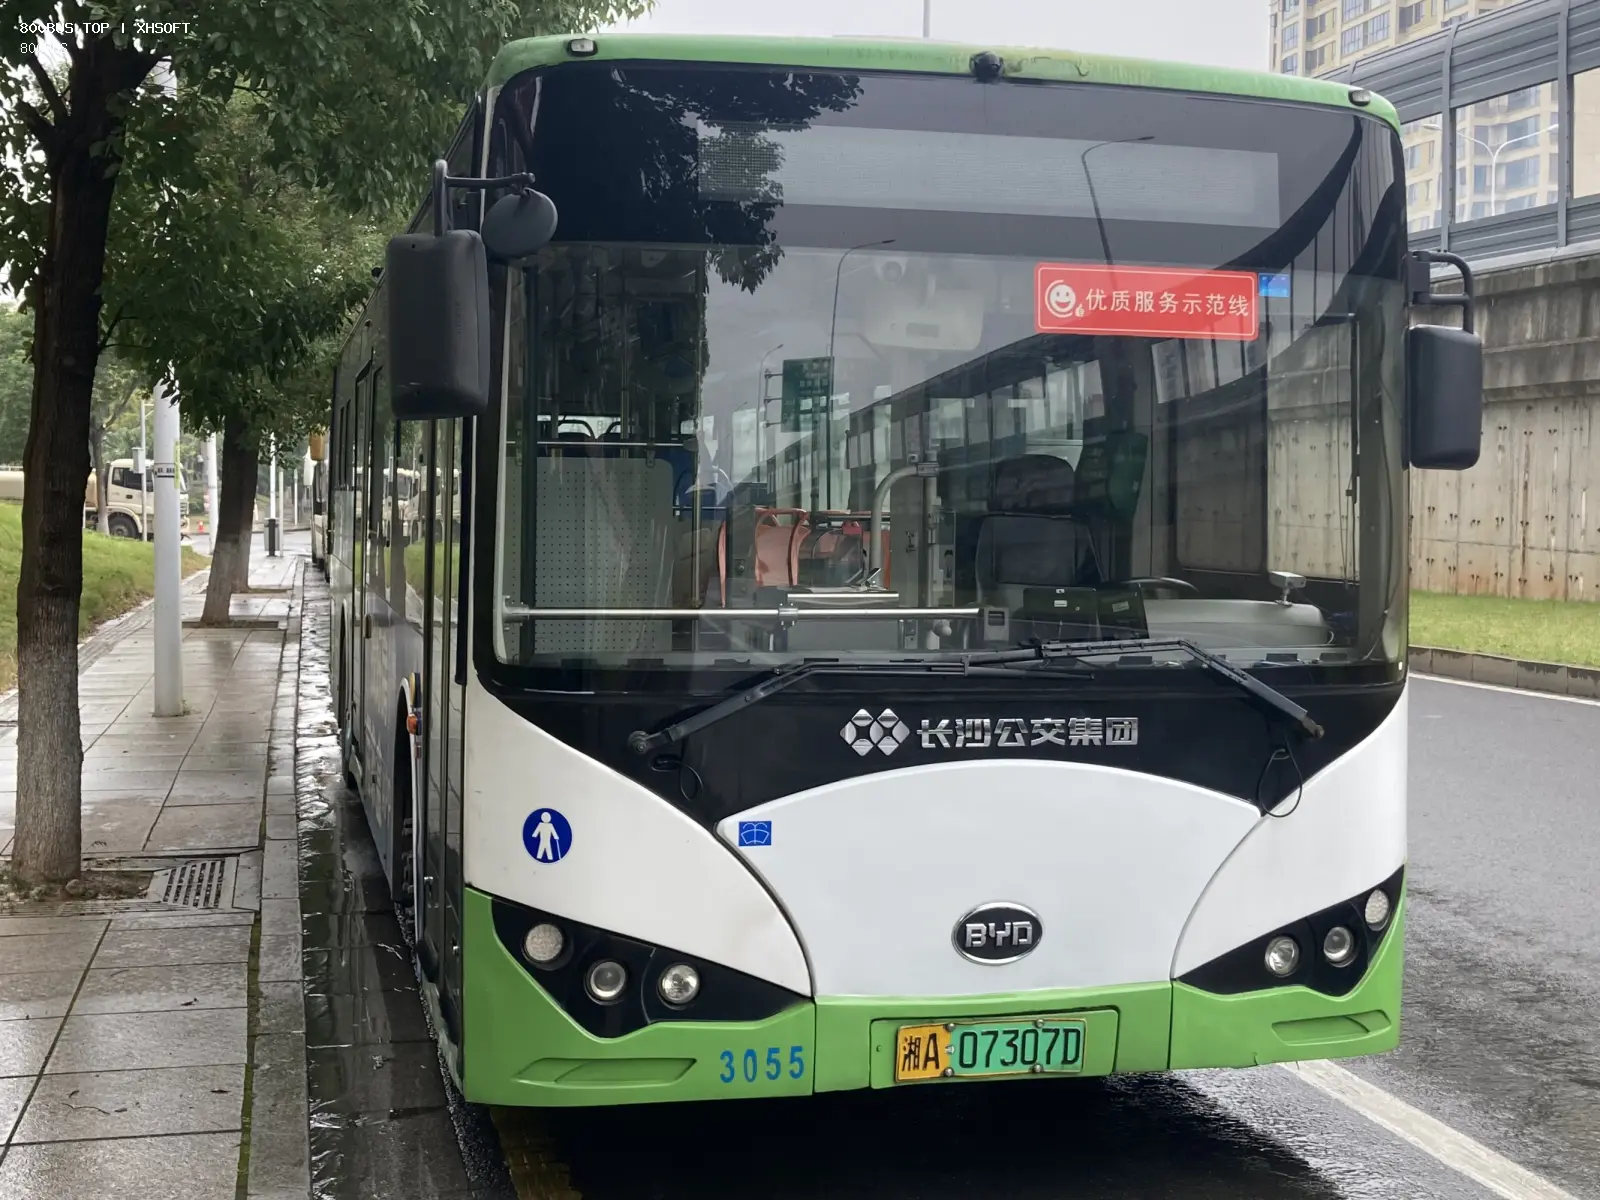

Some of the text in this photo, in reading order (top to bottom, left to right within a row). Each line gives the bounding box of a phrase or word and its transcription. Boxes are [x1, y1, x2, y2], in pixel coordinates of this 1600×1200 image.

[1086, 288, 1249, 316] 优质服务示范线
[916, 717, 1138, 748] 长沙公交集团
[965, 921, 1033, 947] BYD
[719, 1045, 805, 1083] 3055
